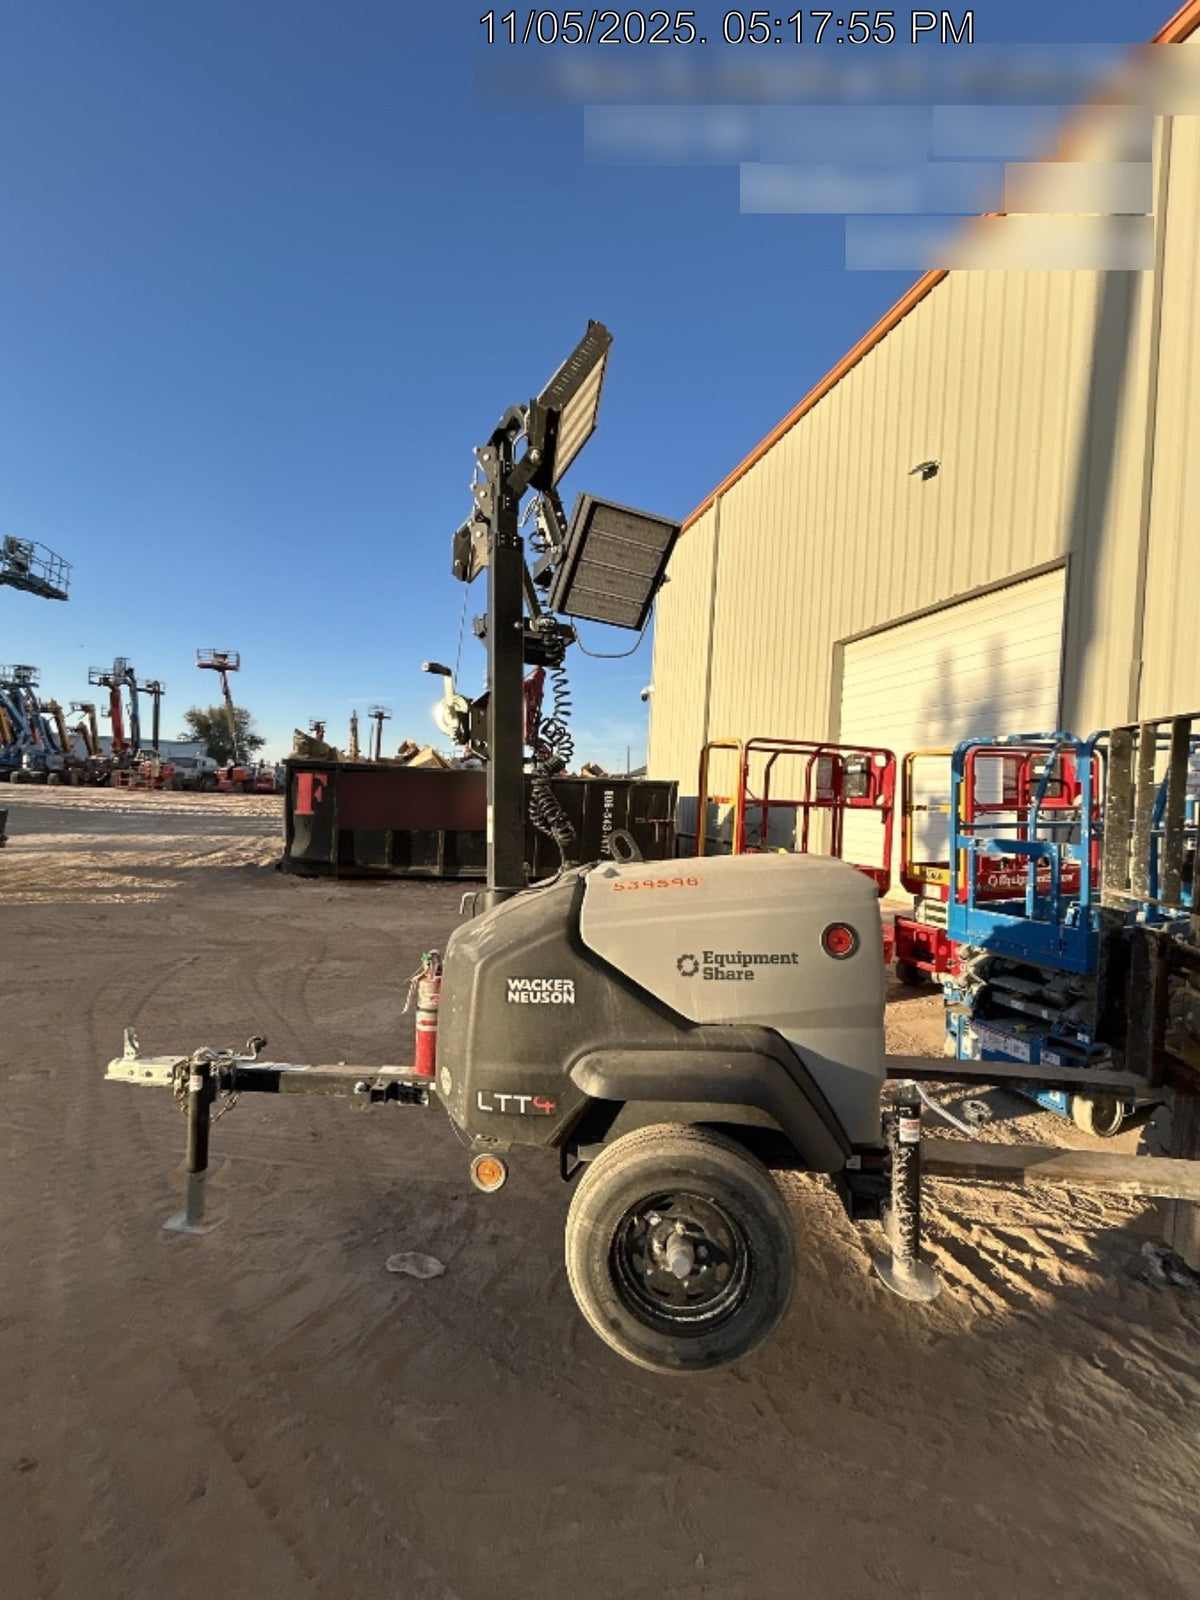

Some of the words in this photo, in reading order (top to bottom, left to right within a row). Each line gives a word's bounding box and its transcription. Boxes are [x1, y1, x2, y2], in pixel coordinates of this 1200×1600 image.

[702, 950, 799, 967] Equipment
[703, 966, 755, 981] Share
[507, 978, 575, 991] WACKER
[507, 991, 575, 1004] NEUSON
[477, 1091, 555, 1114] LTT4
